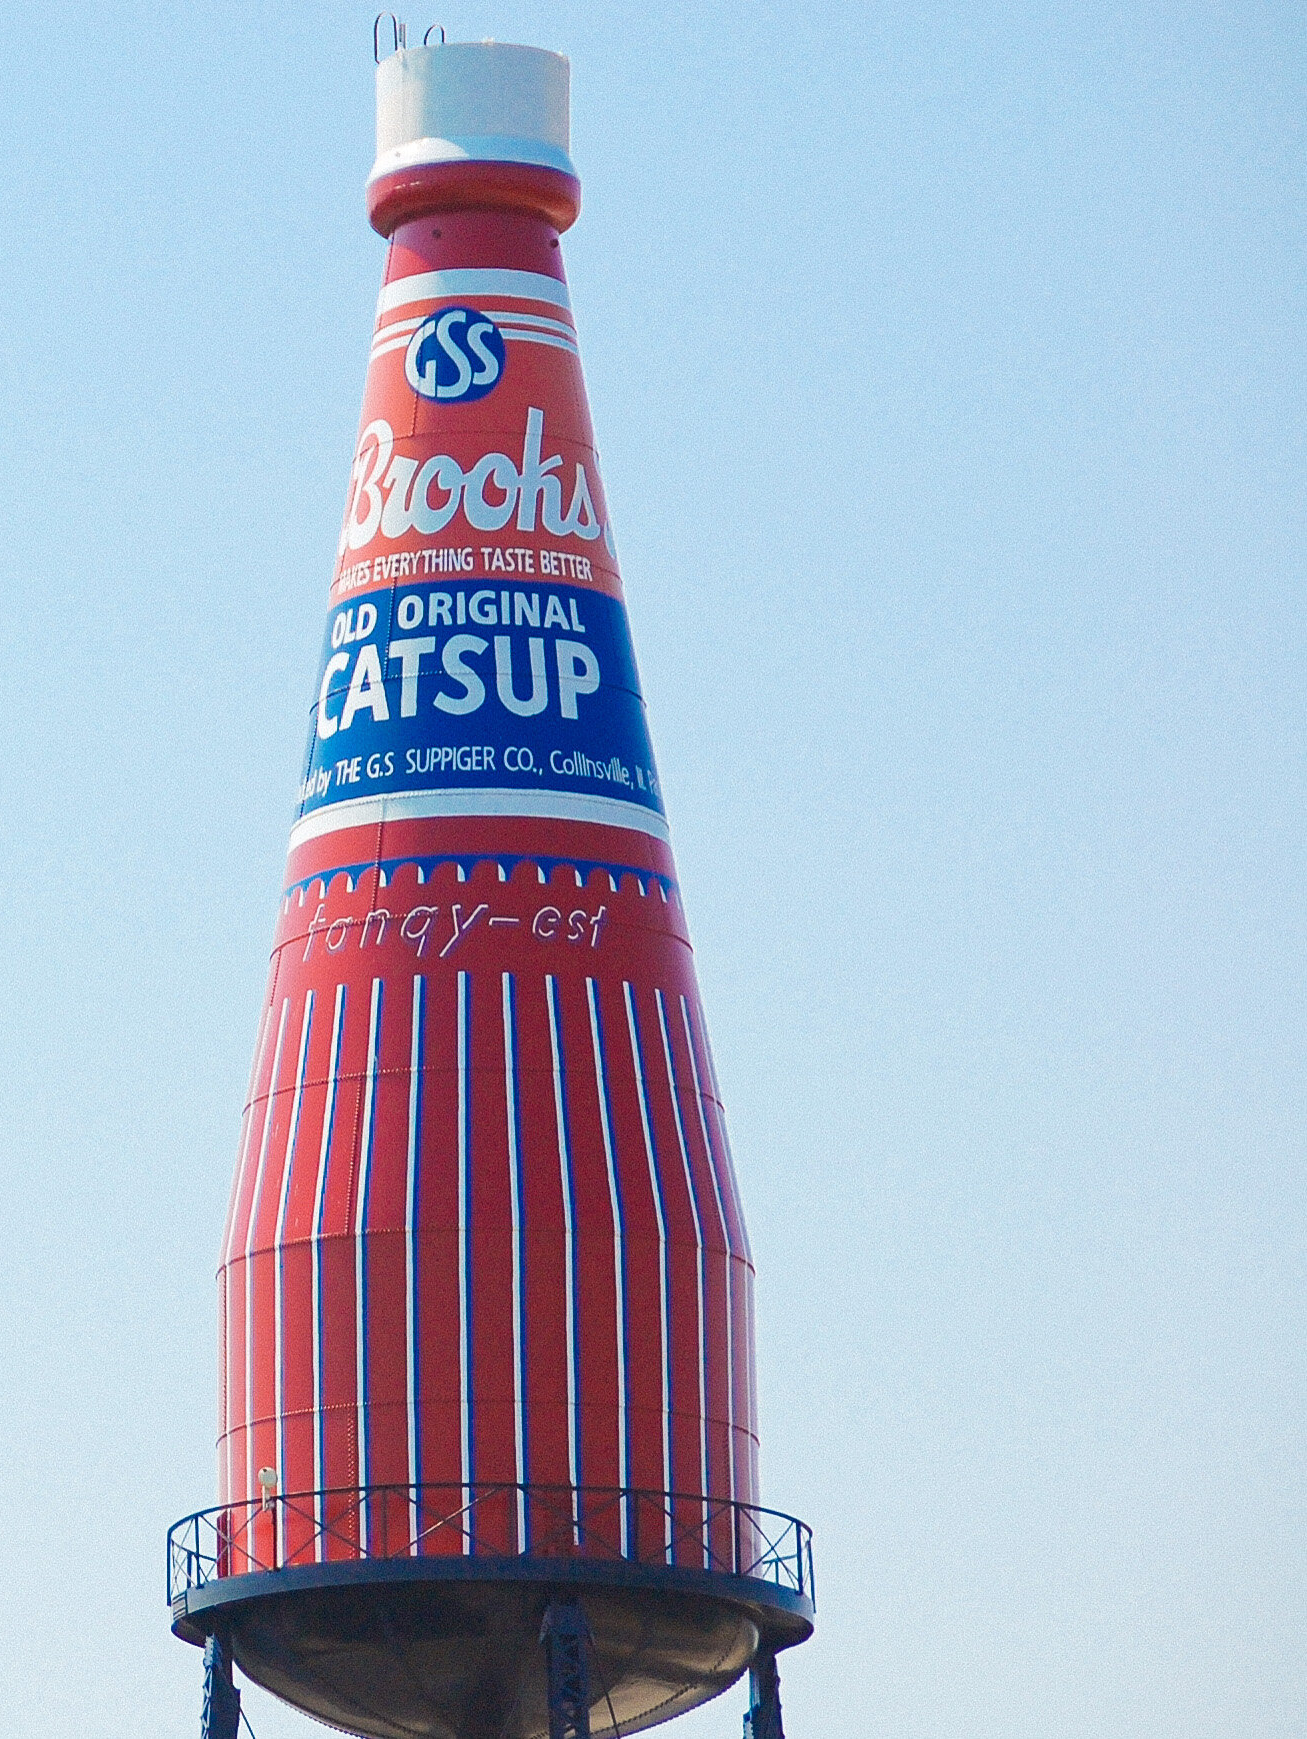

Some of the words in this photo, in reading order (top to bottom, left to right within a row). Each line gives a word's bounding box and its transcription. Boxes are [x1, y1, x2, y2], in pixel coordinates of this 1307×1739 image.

[405, 310, 499, 397] GSS
[340, 407, 600, 556] Brooks
[373, 547, 474, 582] EVERYTHING
[481, 547, 534, 574] TASTE
[540, 551, 593, 582] BETTER
[332, 603, 378, 647] OLD
[397, 590, 586, 633] ORIGINAL
[316, 633, 601, 741] CATSUP
[335, 756, 363, 787] THE
[405, 745, 497, 774] SUPPIGER
[503, 746, 543, 776] CO.,
